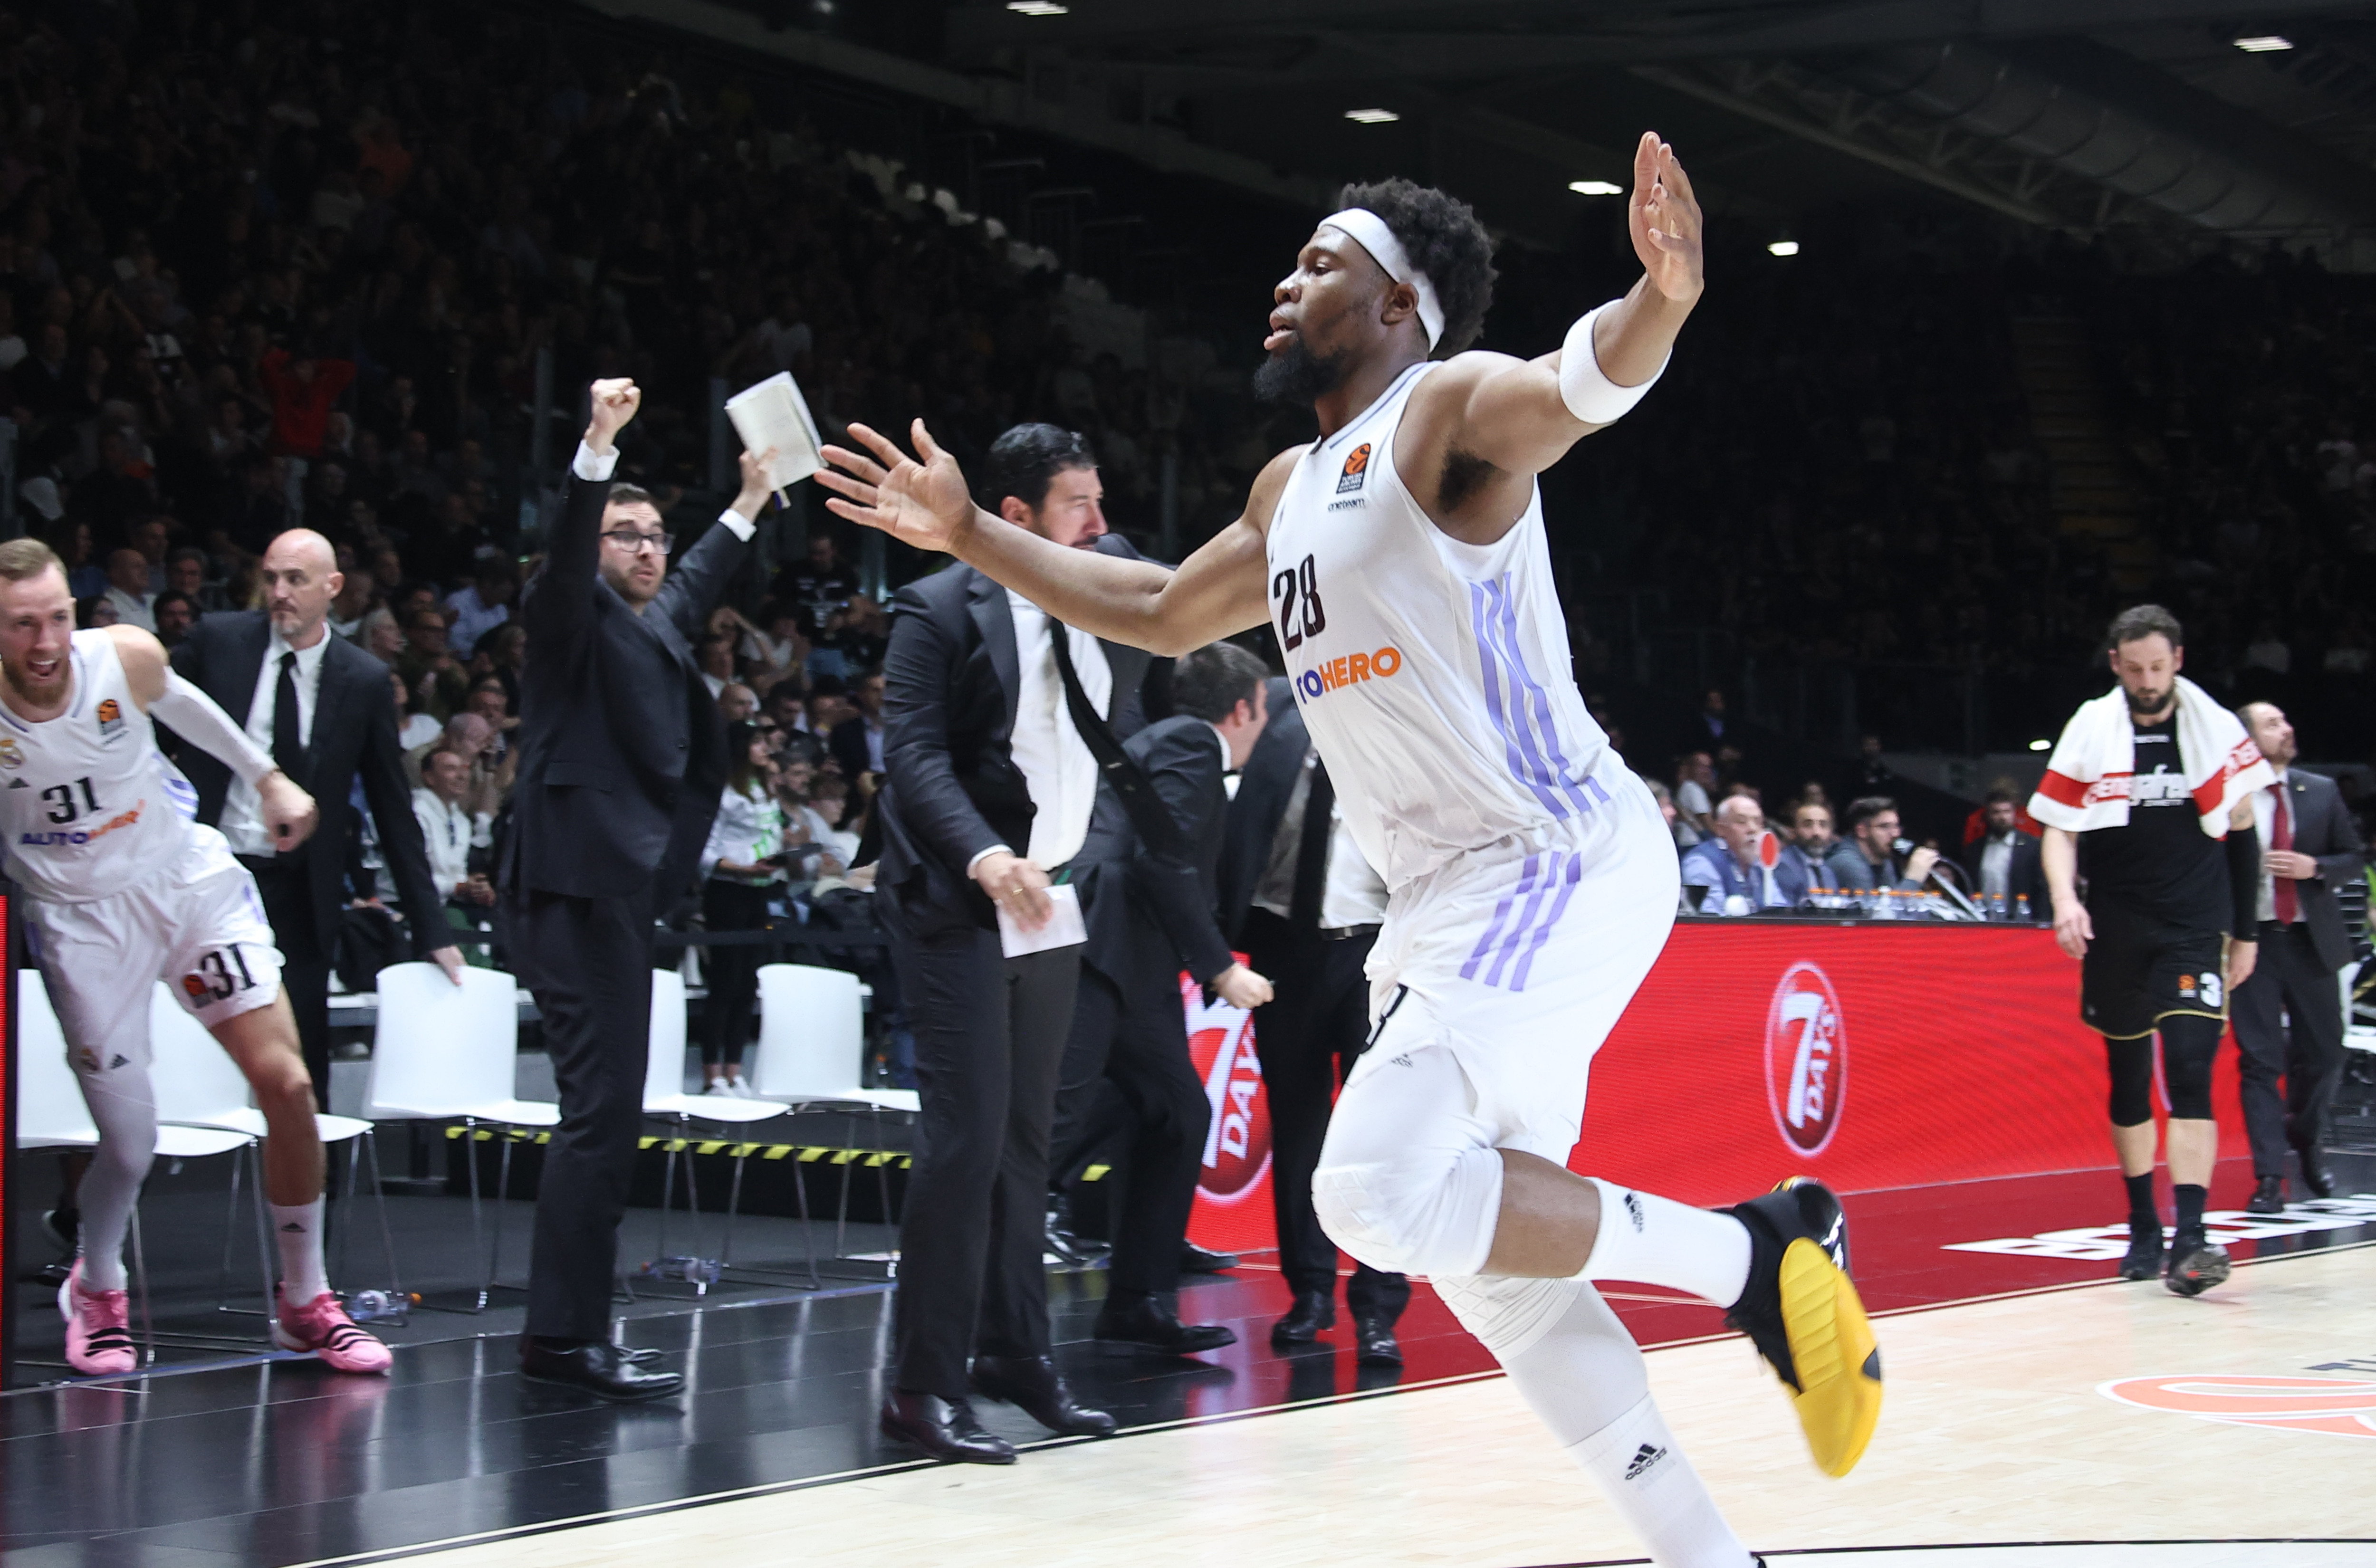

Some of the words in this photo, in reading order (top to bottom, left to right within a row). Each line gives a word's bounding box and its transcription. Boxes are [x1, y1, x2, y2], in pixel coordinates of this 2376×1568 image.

[1274, 553, 1325, 652] 28
[42, 776, 102, 824] 31
[201, 943, 257, 1000] 31
[2199, 971, 2223, 1007] 3
[1779, 989, 1825, 1129] 7
